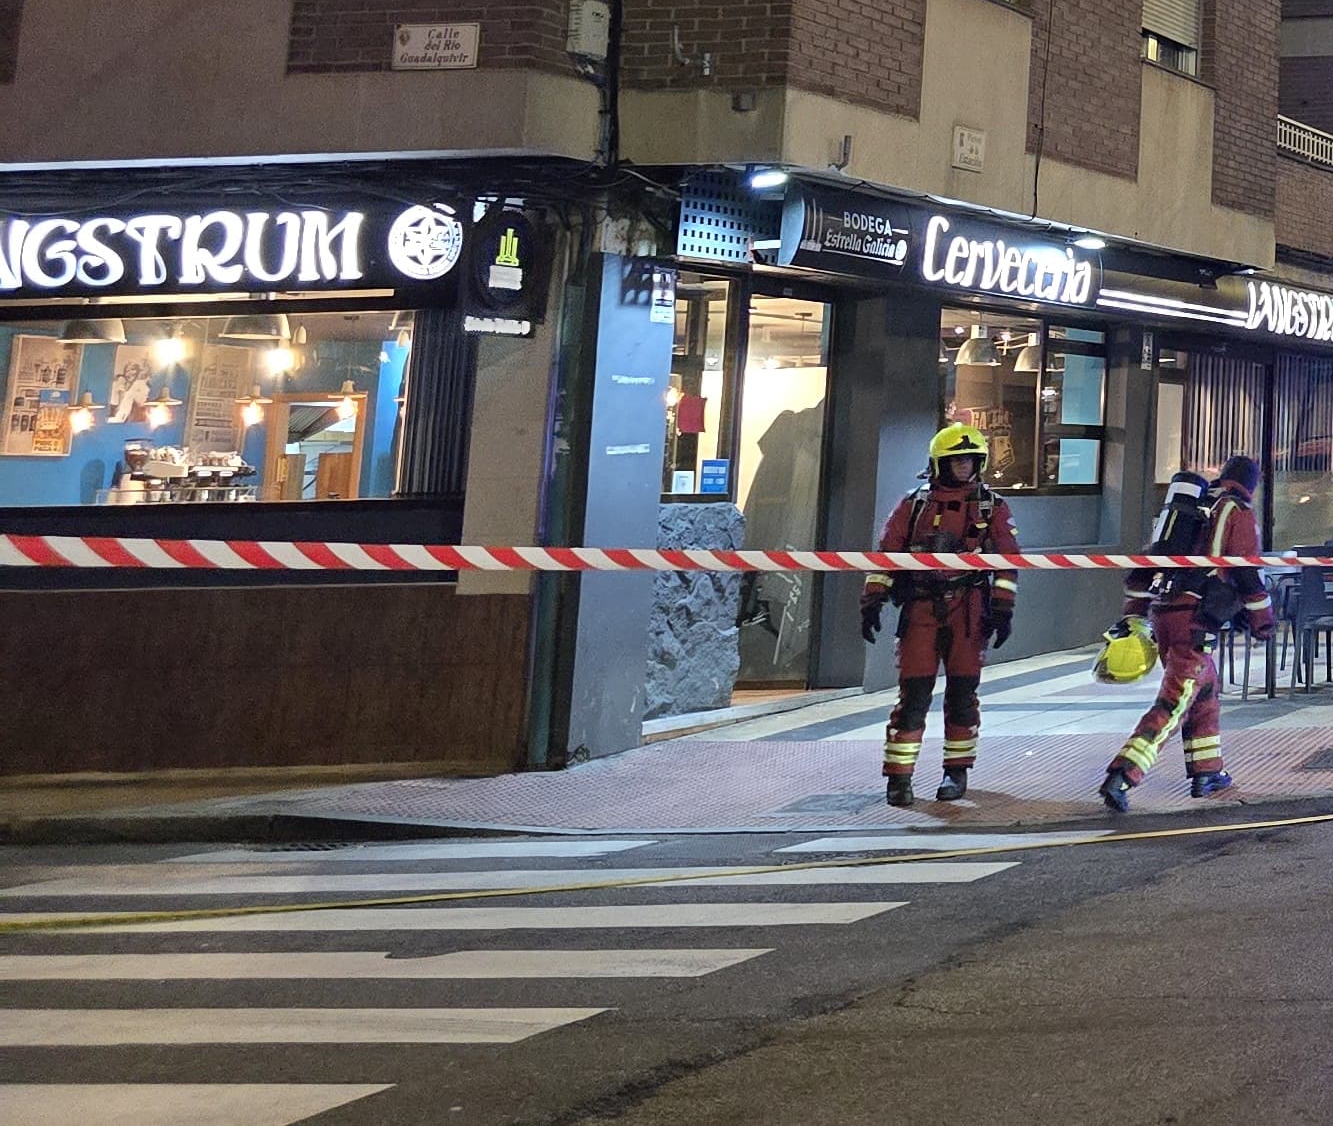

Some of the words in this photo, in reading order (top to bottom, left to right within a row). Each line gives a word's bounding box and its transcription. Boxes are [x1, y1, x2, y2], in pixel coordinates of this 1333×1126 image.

[428, 28, 459, 40] Calle
[424, 40, 440, 51] del
[400, 52, 468, 66] Guadalquivir
[844, 211, 893, 236] BODEGA
[824, 228, 862, 252] Estrella
[862, 235, 896, 258] Galicia
